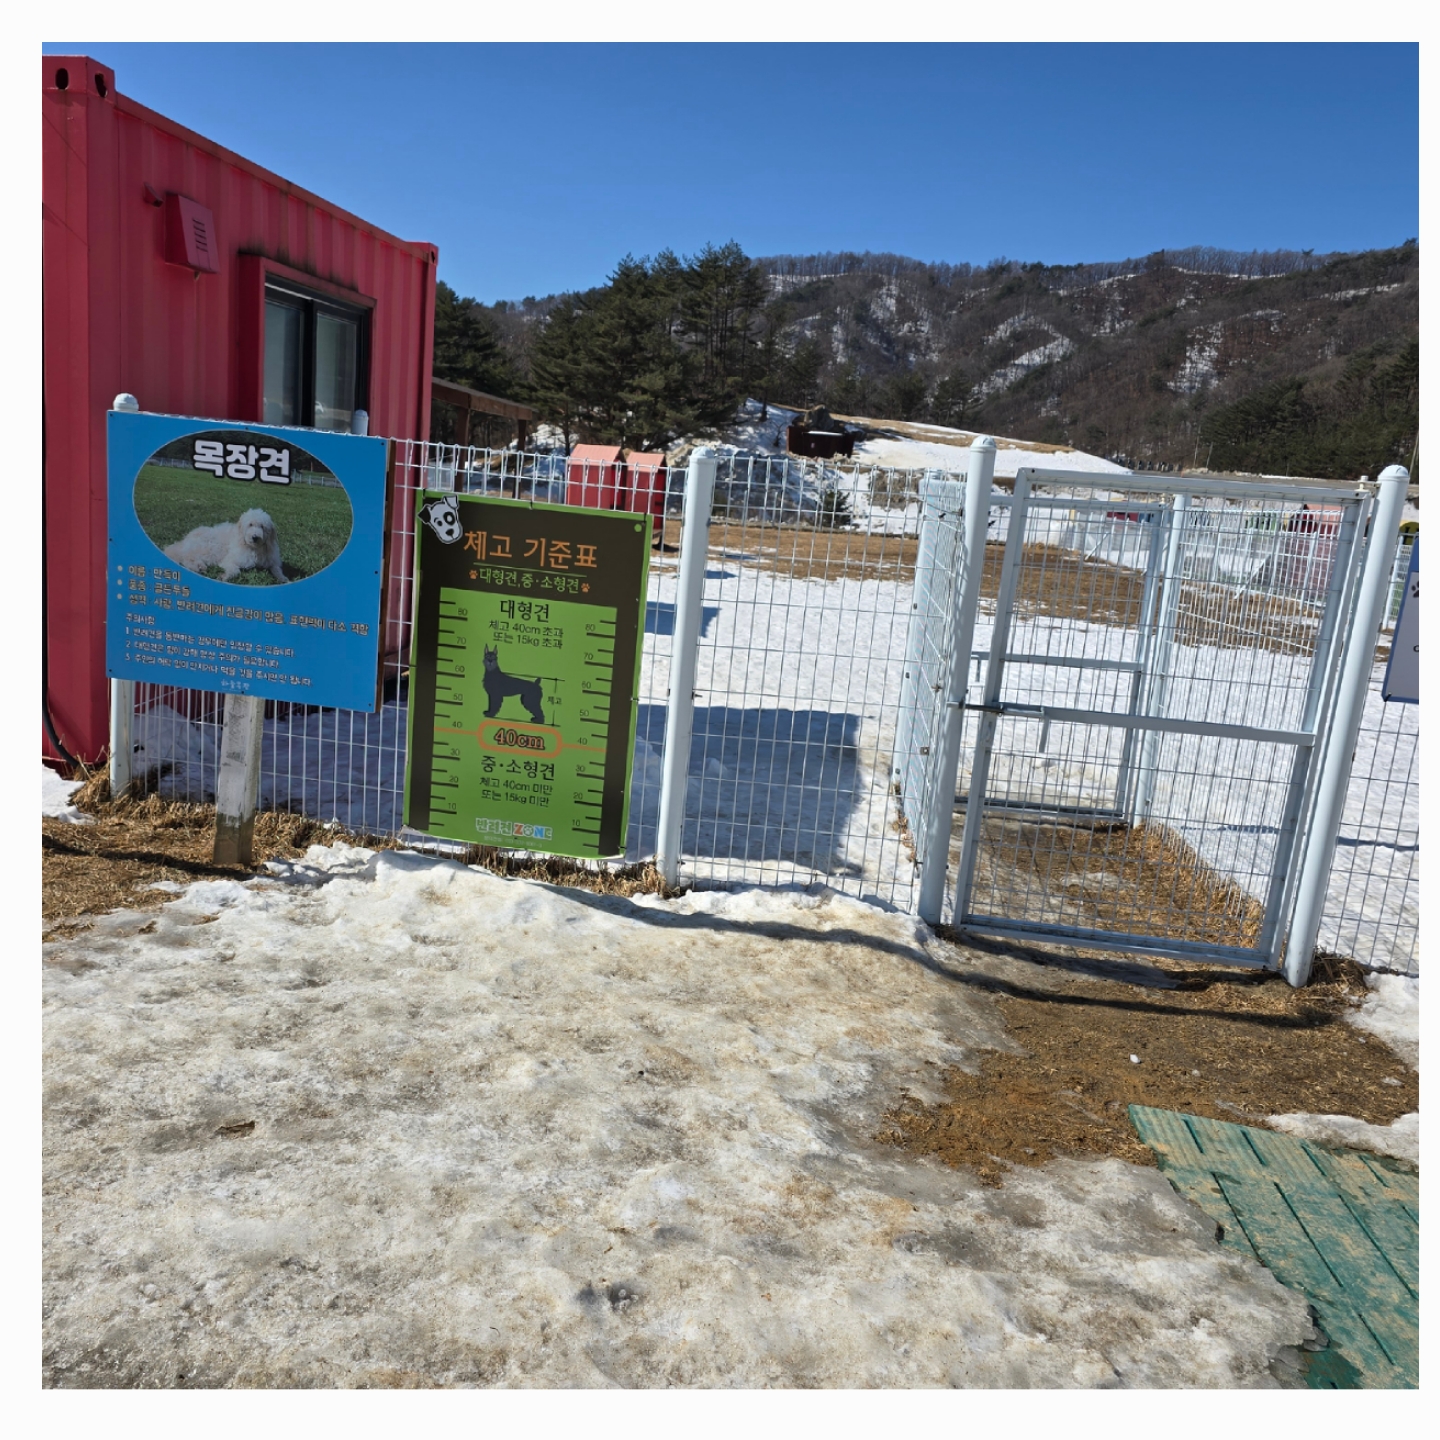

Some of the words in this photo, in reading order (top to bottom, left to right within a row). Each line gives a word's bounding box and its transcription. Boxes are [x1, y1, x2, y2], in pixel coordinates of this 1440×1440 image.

[192, 439, 290, 485] 목장견
[463, 530, 513, 560] 체고
[523, 538, 598, 570] 기준표
[458, 608, 468, 616] 80
[500, 599, 550, 623] 대형견
[488, 620, 510, 632] 체고
[512, 622, 540, 636] 40cm
[542, 627, 564, 639] 초과
[585, 624, 596, 632] 80
[456, 637, 466, 645] 70
[492, 632, 514, 644] 또는
[517, 634, 540, 647] 15kg
[542, 638, 563, 650] 초과
[584, 652, 594, 660] 70
[454, 665, 465, 673] 60
[582, 681, 592, 689] 60
[452, 720, 462, 728] 40
[494, 728, 546, 750] 40cm
[578, 738, 588, 746] 40
[576, 764, 586, 772] 30
[479, 776, 500, 788] 체고
[502, 780, 530, 791] 40cm
[532, 784, 553, 796] 미만
[481, 789, 502, 801] 또는
[504, 792, 527, 804] 15kg
[529, 796, 550, 808] 미만
[573, 792, 584, 800] 20
[448, 802, 456, 810] 10
[572, 819, 580, 827] 10
